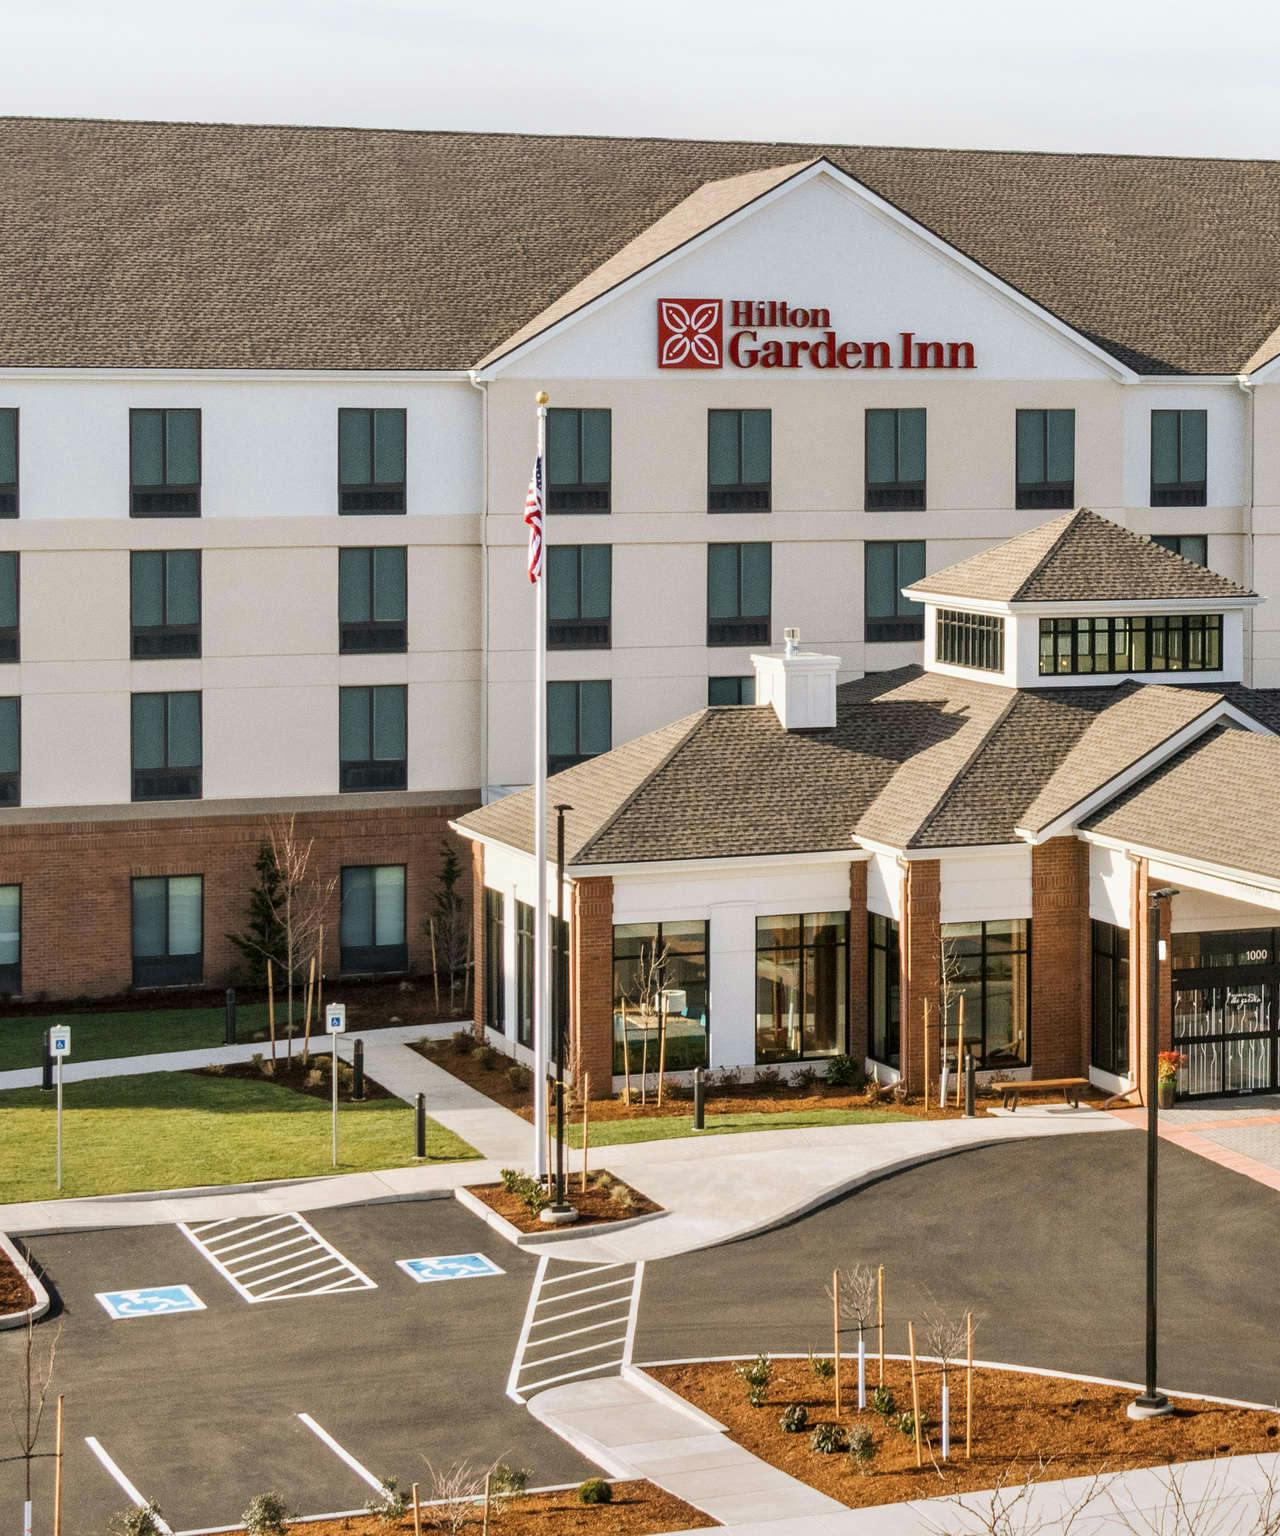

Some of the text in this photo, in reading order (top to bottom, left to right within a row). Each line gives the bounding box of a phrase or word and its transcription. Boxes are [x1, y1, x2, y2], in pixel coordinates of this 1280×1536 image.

[729, 300, 832, 328] Hilton
[729, 330, 978, 369] Garden Inn
[1246, 949, 1267, 960] 1000
